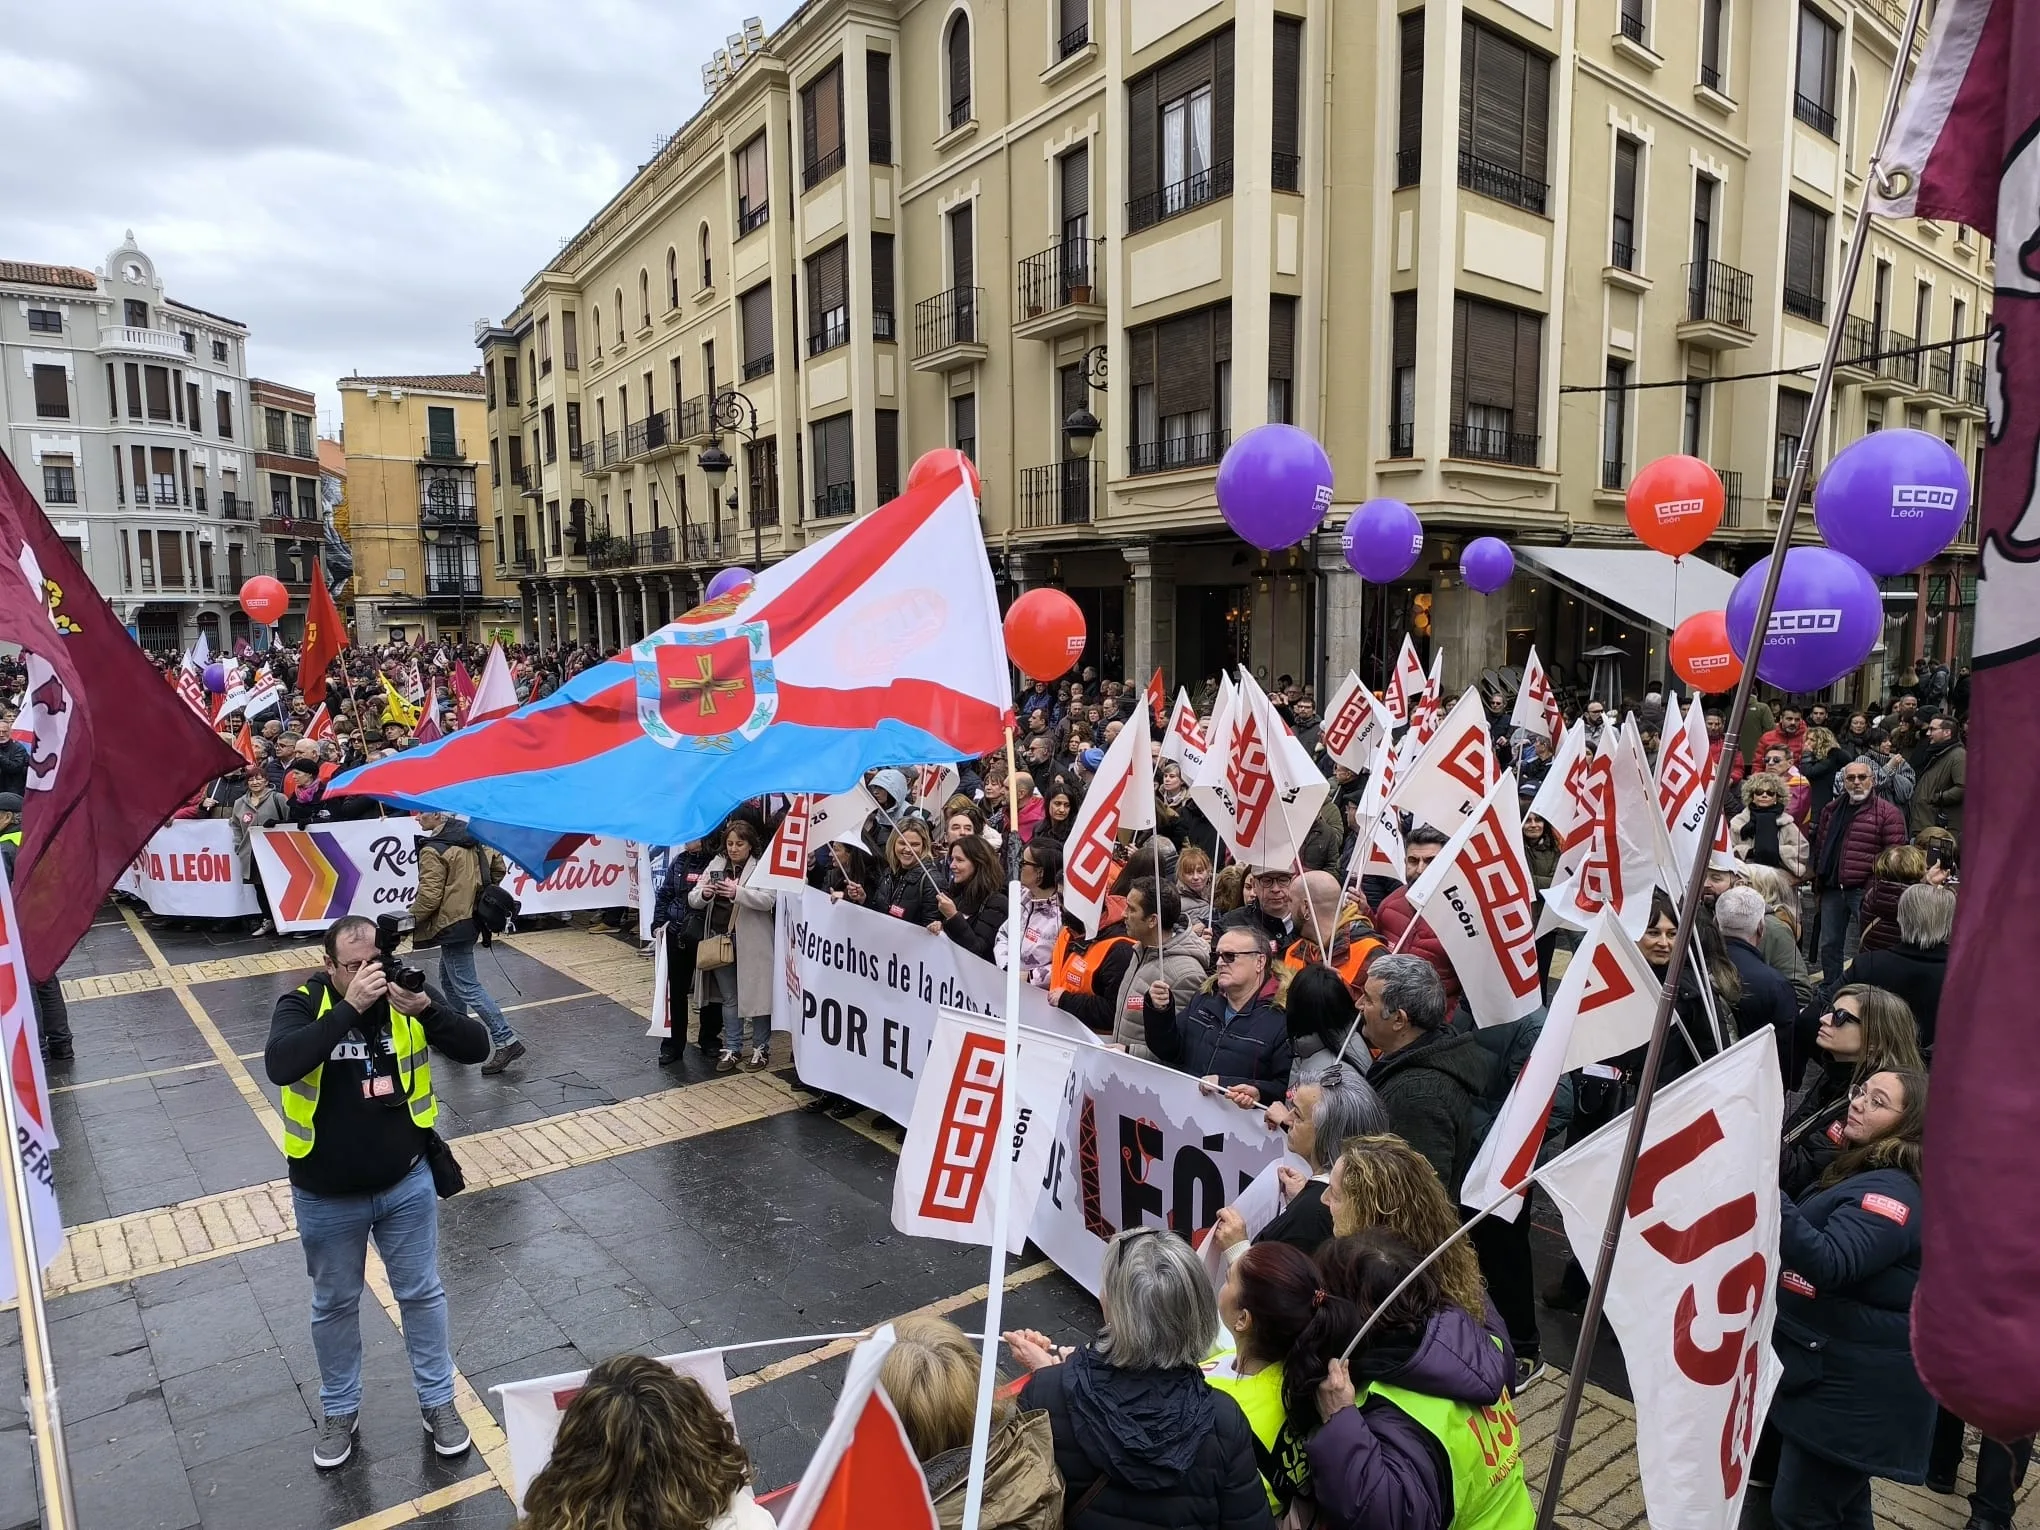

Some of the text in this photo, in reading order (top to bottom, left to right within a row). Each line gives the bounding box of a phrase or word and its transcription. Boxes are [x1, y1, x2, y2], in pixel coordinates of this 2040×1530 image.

[1659, 502, 1701, 515] CCOO
[1898, 489, 1954, 506] CCOO
[1658, 516, 1681, 526] León
[1891, 507, 1924, 519] León
[1767, 614, 1836, 631] CCOO
[1763, 635, 1796, 646] León
[1691, 656, 1728, 667] CCOO
[1327, 688, 1370, 751] CCOO
[1357, 721, 1376, 743] León
[169, 847, 232, 882] LEÓN
[369, 836, 419, 877] Rec
[373, 886, 419, 909] con
[1463, 819, 1539, 982] CCOO
[1442, 884, 1477, 939] León
[888, 953, 911, 993] de
[918, 961, 933, 1005] la
[801, 989, 914, 1080] POR EL
[932, 1047, 1005, 1211] CCOO
[1012, 1107, 1033, 1163] León
[1866, 1194, 1907, 1216] CCOO
